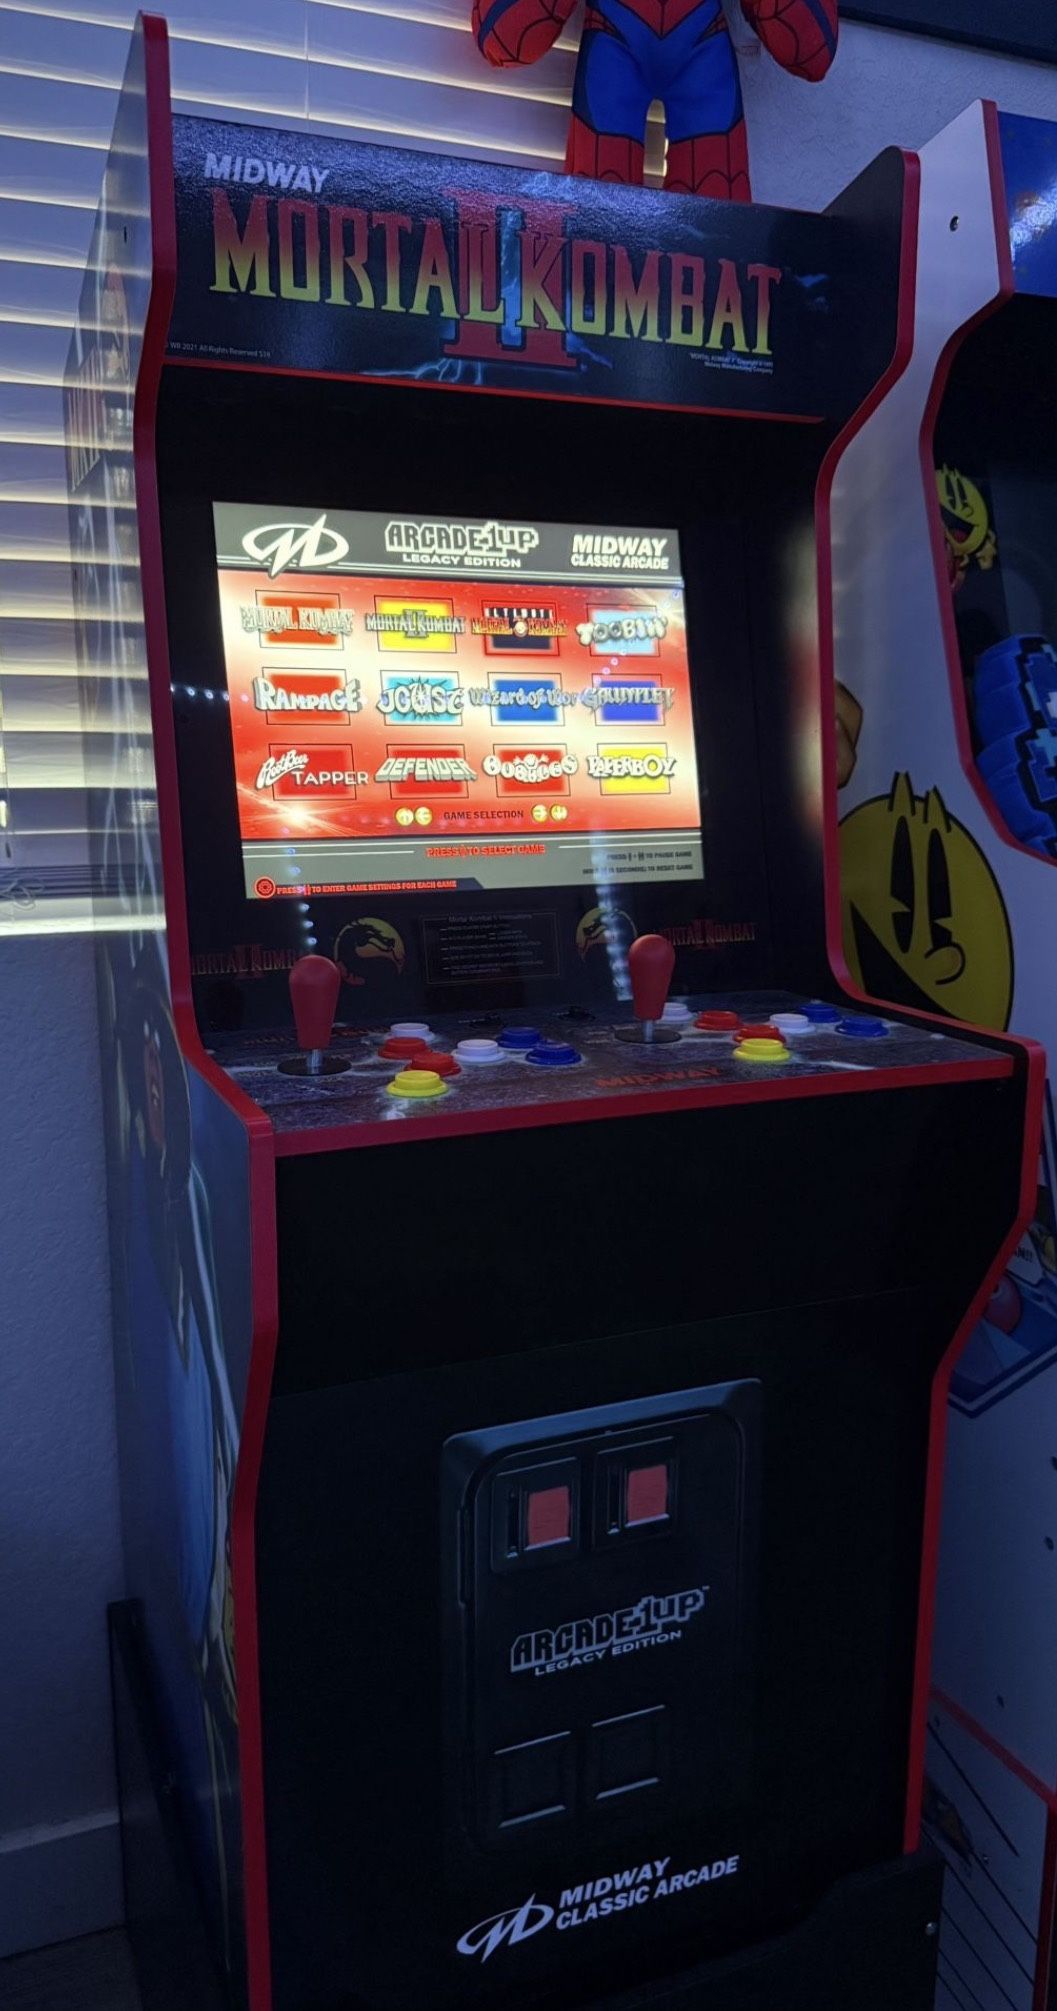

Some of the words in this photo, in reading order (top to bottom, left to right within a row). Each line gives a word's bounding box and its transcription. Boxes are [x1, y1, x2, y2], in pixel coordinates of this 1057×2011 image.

[204, 153, 330, 193] MIDWAY
[209, 186, 504, 324] MORTAL
[513, 229, 782, 355] KOMBAT
[572, 534, 668, 556] MIDWAY
[402, 553, 460, 565] LEGACY
[464, 555, 521, 568] EDITION
[571, 555, 620, 568] CLASSIC
[621, 557, 669, 570] ARCADE
[253, 677, 362, 712] RAMPAGE
[291, 770, 369, 785] TAPPER
[375, 757, 478, 782] DEFENDER
[444, 811, 471, 820] GAME
[473, 810, 524, 819] SELECTION
[426, 847, 457, 858] PRESS
[469, 846, 480, 857] TO
[480, 845, 516, 856] SELECT
[517, 844, 545, 854] GAME
[276, 886, 304, 895] PRESS
[322, 885, 346, 893] ENTER
[346, 884, 368, 892] GAME
[368, 883, 401, 891] SETTINGS
[402, 882, 416, 890] FOR
[417, 881, 436, 889] EACH
[437, 880, 457, 888] GAME
[595, 1066, 722, 1087] MIDWAY
[534, 1649, 606, 1676] LEGACY
[611, 1630, 682, 1656] EDITION
[556, 1885, 650, 1930] CLASSIC
[653, 1855, 740, 1898] ARCADE
[559, 1856, 671, 1908] MIDWAY
